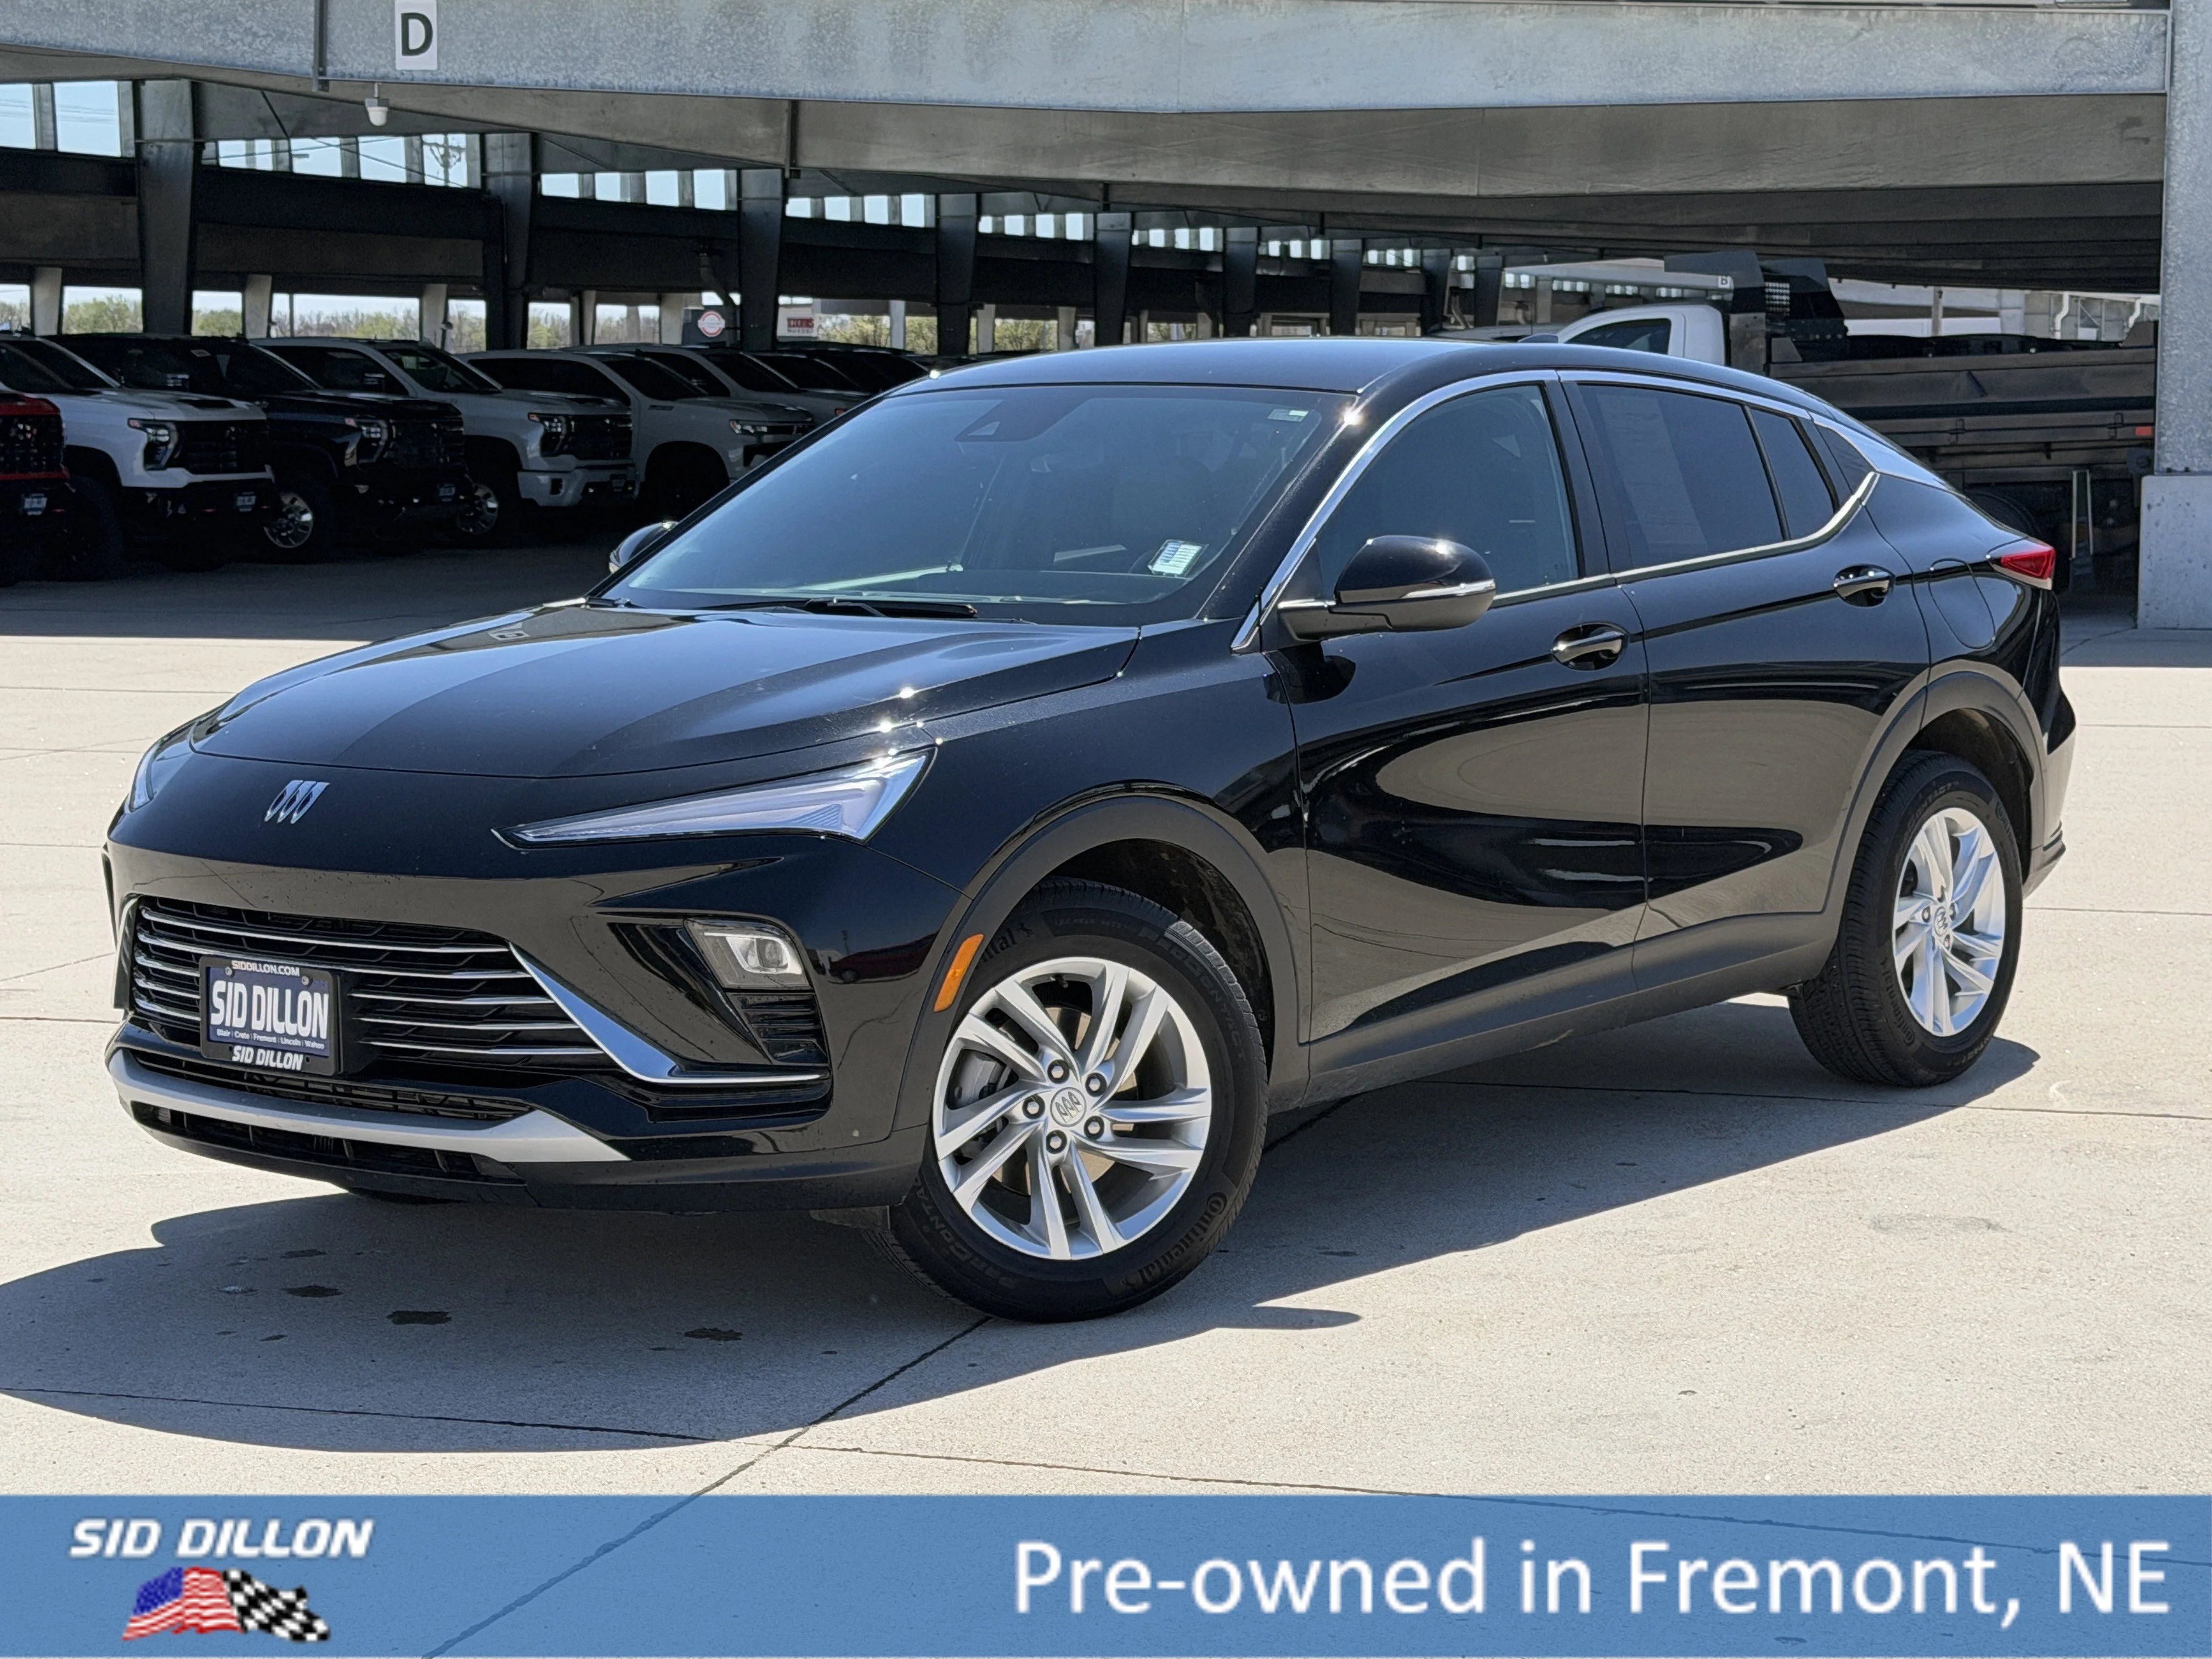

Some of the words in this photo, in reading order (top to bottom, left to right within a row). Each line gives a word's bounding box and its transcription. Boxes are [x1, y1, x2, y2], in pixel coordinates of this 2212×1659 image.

[400, 12, 433, 57] D
[231, 960, 301, 977] SIDDILLON.COM
[210, 980, 248, 1029] SID
[251, 985, 329, 1040] DILLON
[253, 1033, 277, 1043] Fremont
[280, 1037, 301, 1047] Lincoln
[232, 1045, 255, 1065] SID
[255, 1048, 304, 1071] DILLON
[1137, 1192, 1228, 1283] Continental
